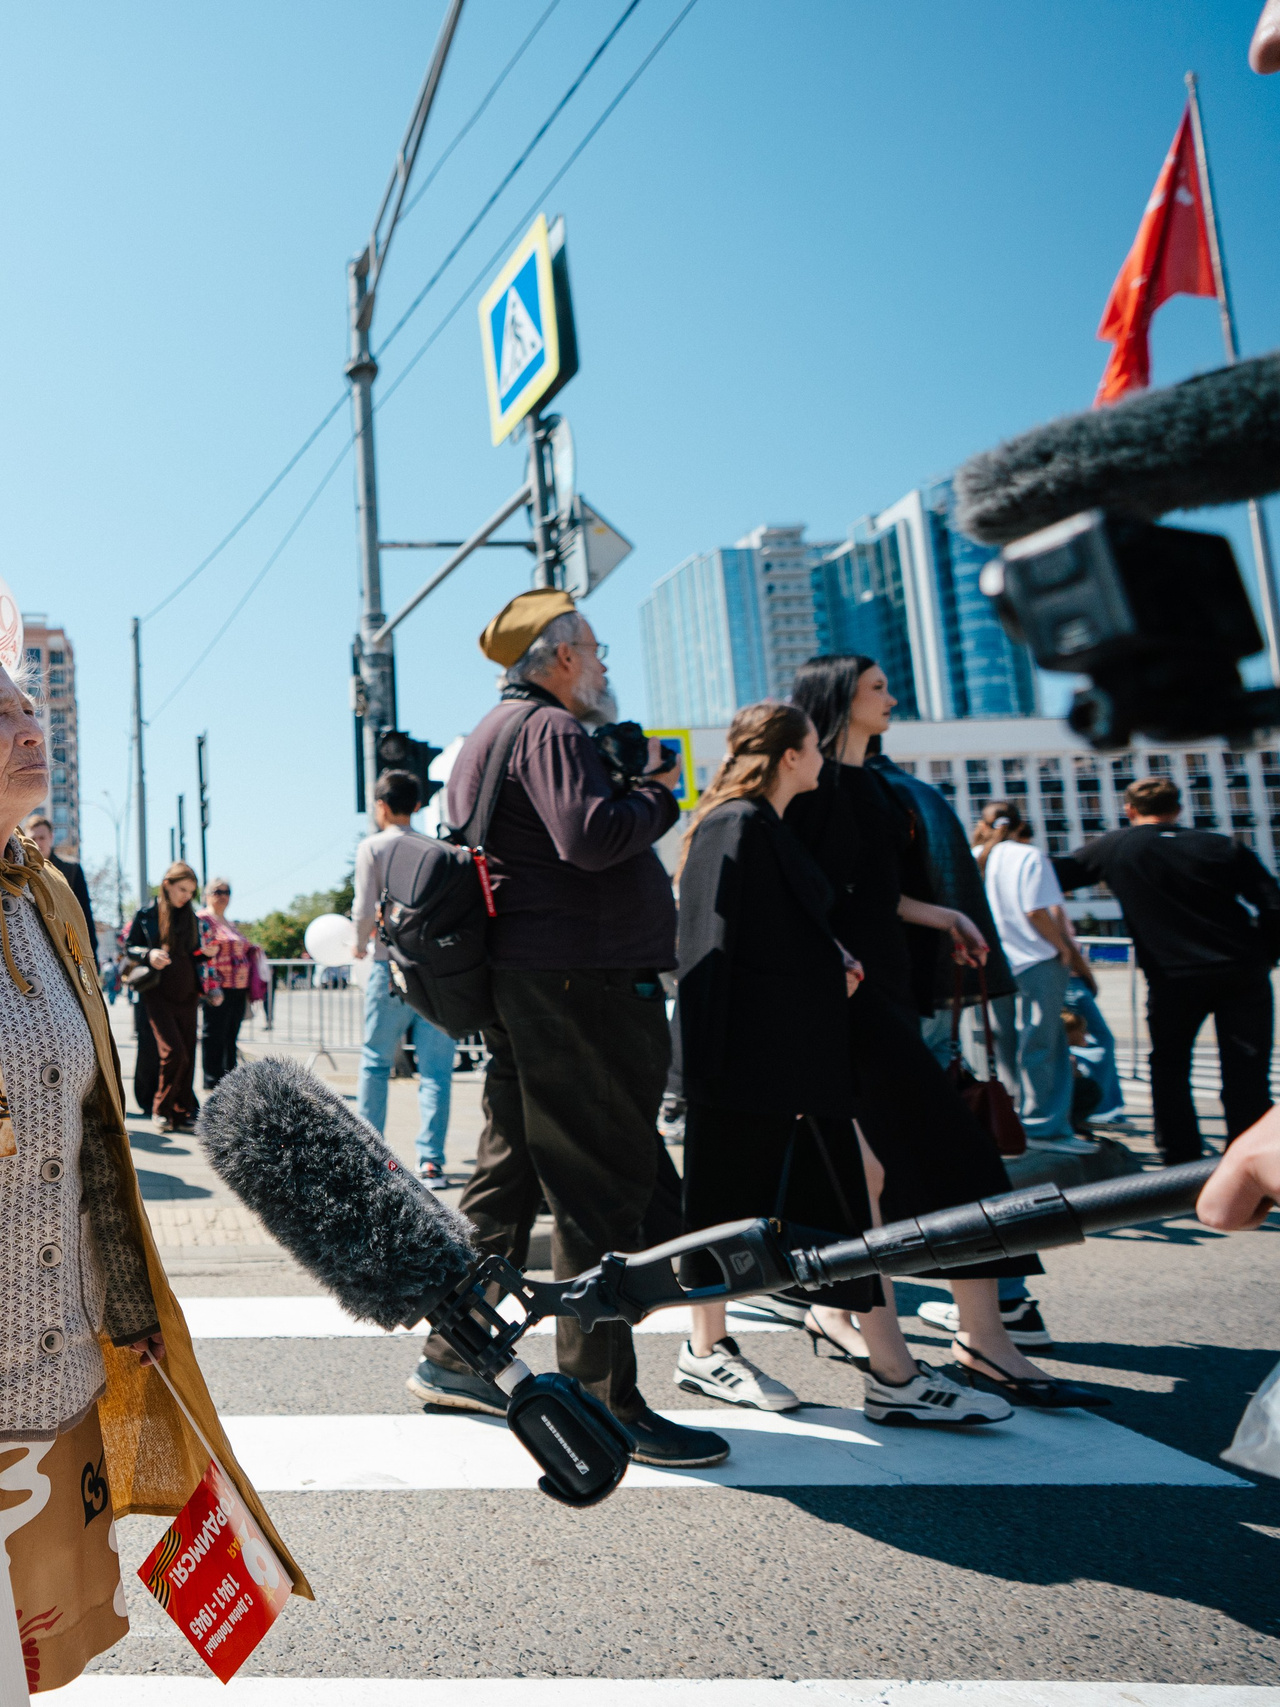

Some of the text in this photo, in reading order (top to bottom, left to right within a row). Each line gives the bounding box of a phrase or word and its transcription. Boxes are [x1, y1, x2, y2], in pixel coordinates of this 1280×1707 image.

[169, 1487, 238, 1589] ГОРДИМСЯ!
[237, 1518, 280, 1589] 9
[189, 1573, 240, 1641] 1941-1945
[204, 1593, 254, 1658] С Днём Победы!
